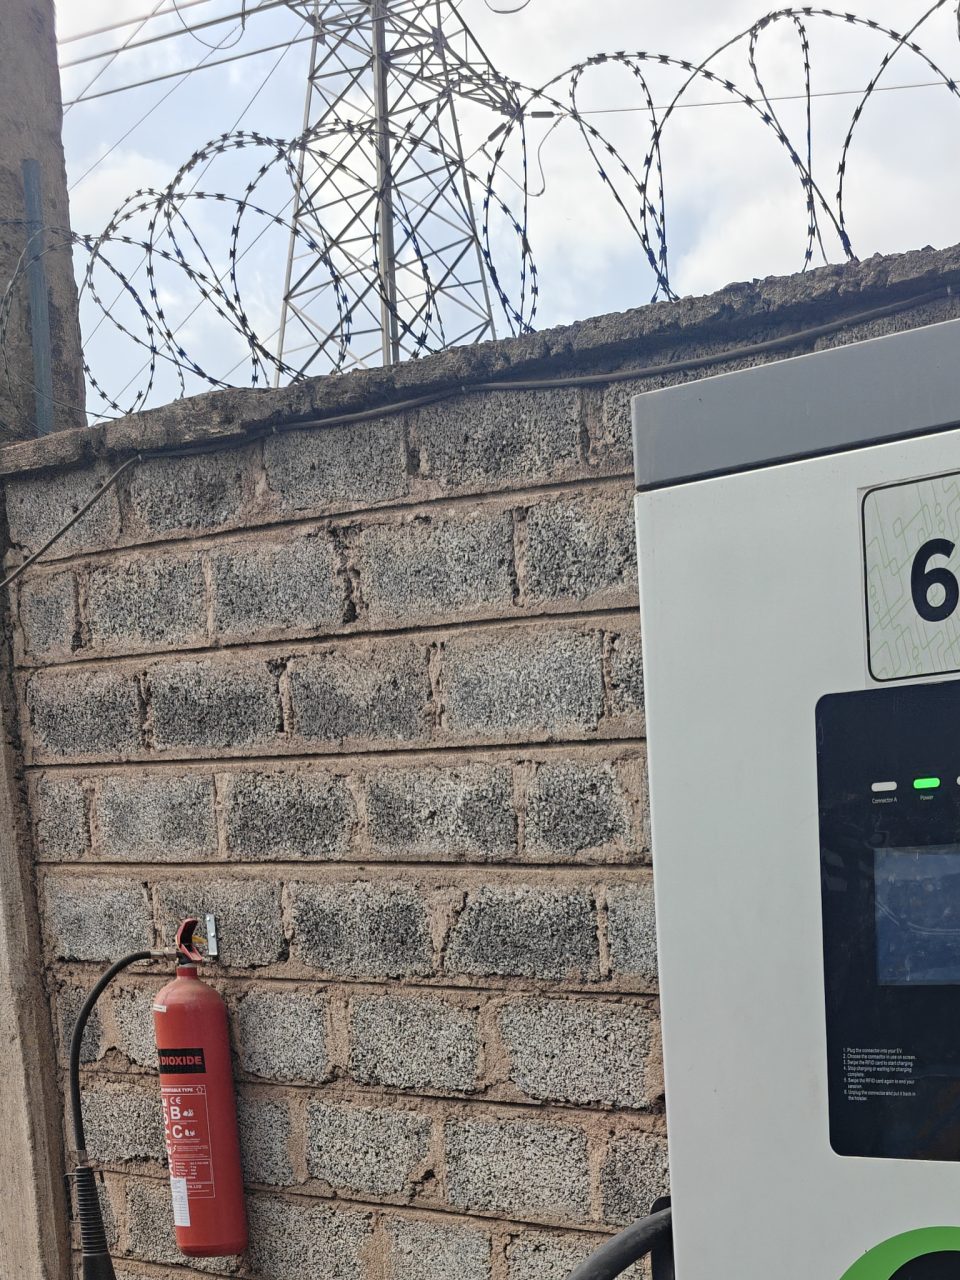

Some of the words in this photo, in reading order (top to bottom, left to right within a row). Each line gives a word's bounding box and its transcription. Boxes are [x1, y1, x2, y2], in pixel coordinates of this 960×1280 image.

[911, 538, 959, 622] 6
[161, 1055, 203, 1066] DIOXIDE
[170, 1106, 181, 1120] B
[172, 1125, 183, 1139] C
